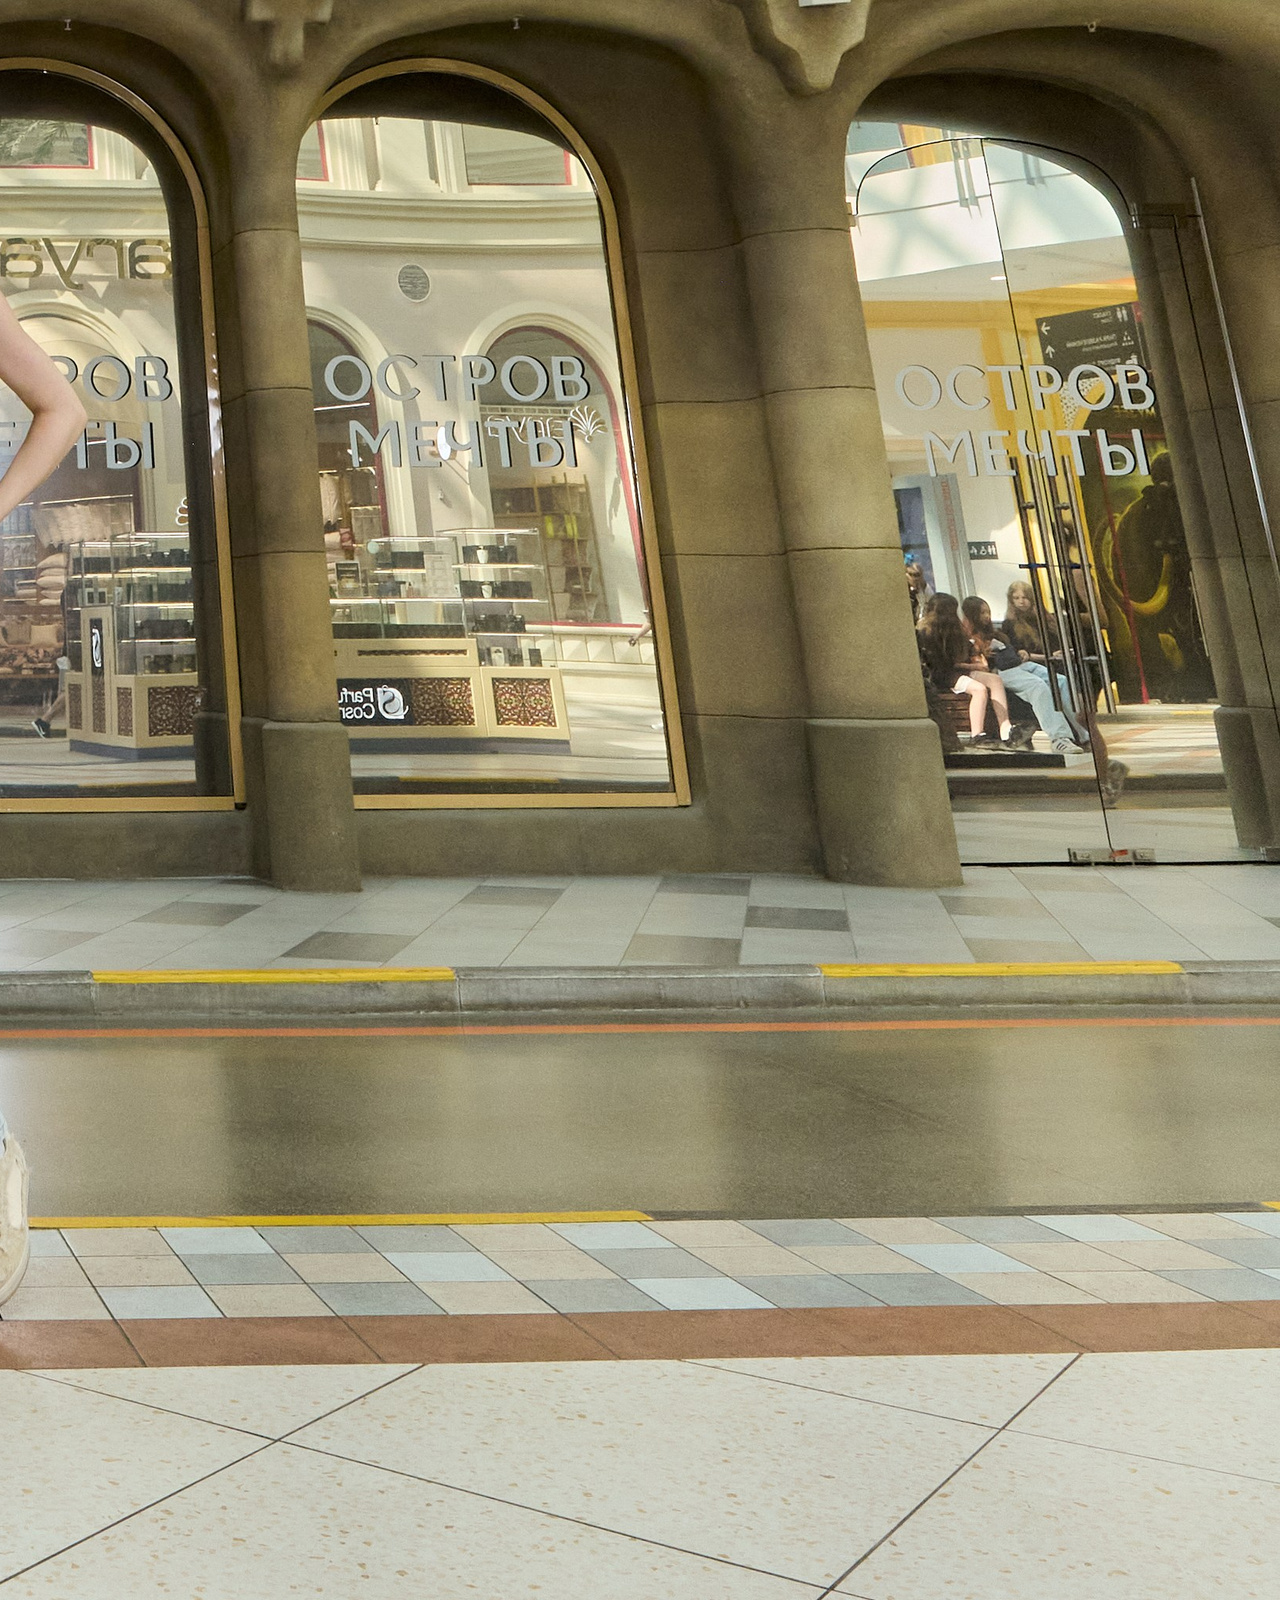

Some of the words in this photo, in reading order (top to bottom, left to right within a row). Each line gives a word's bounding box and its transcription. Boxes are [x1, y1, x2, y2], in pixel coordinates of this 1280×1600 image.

[324, 355, 590, 401] ОСТРОВ
[895, 364, 1155, 411] ОСТРОВ
[349, 420, 578, 467] МЕЧТЫ
[924, 429, 1150, 477] МЕЧТЫ
